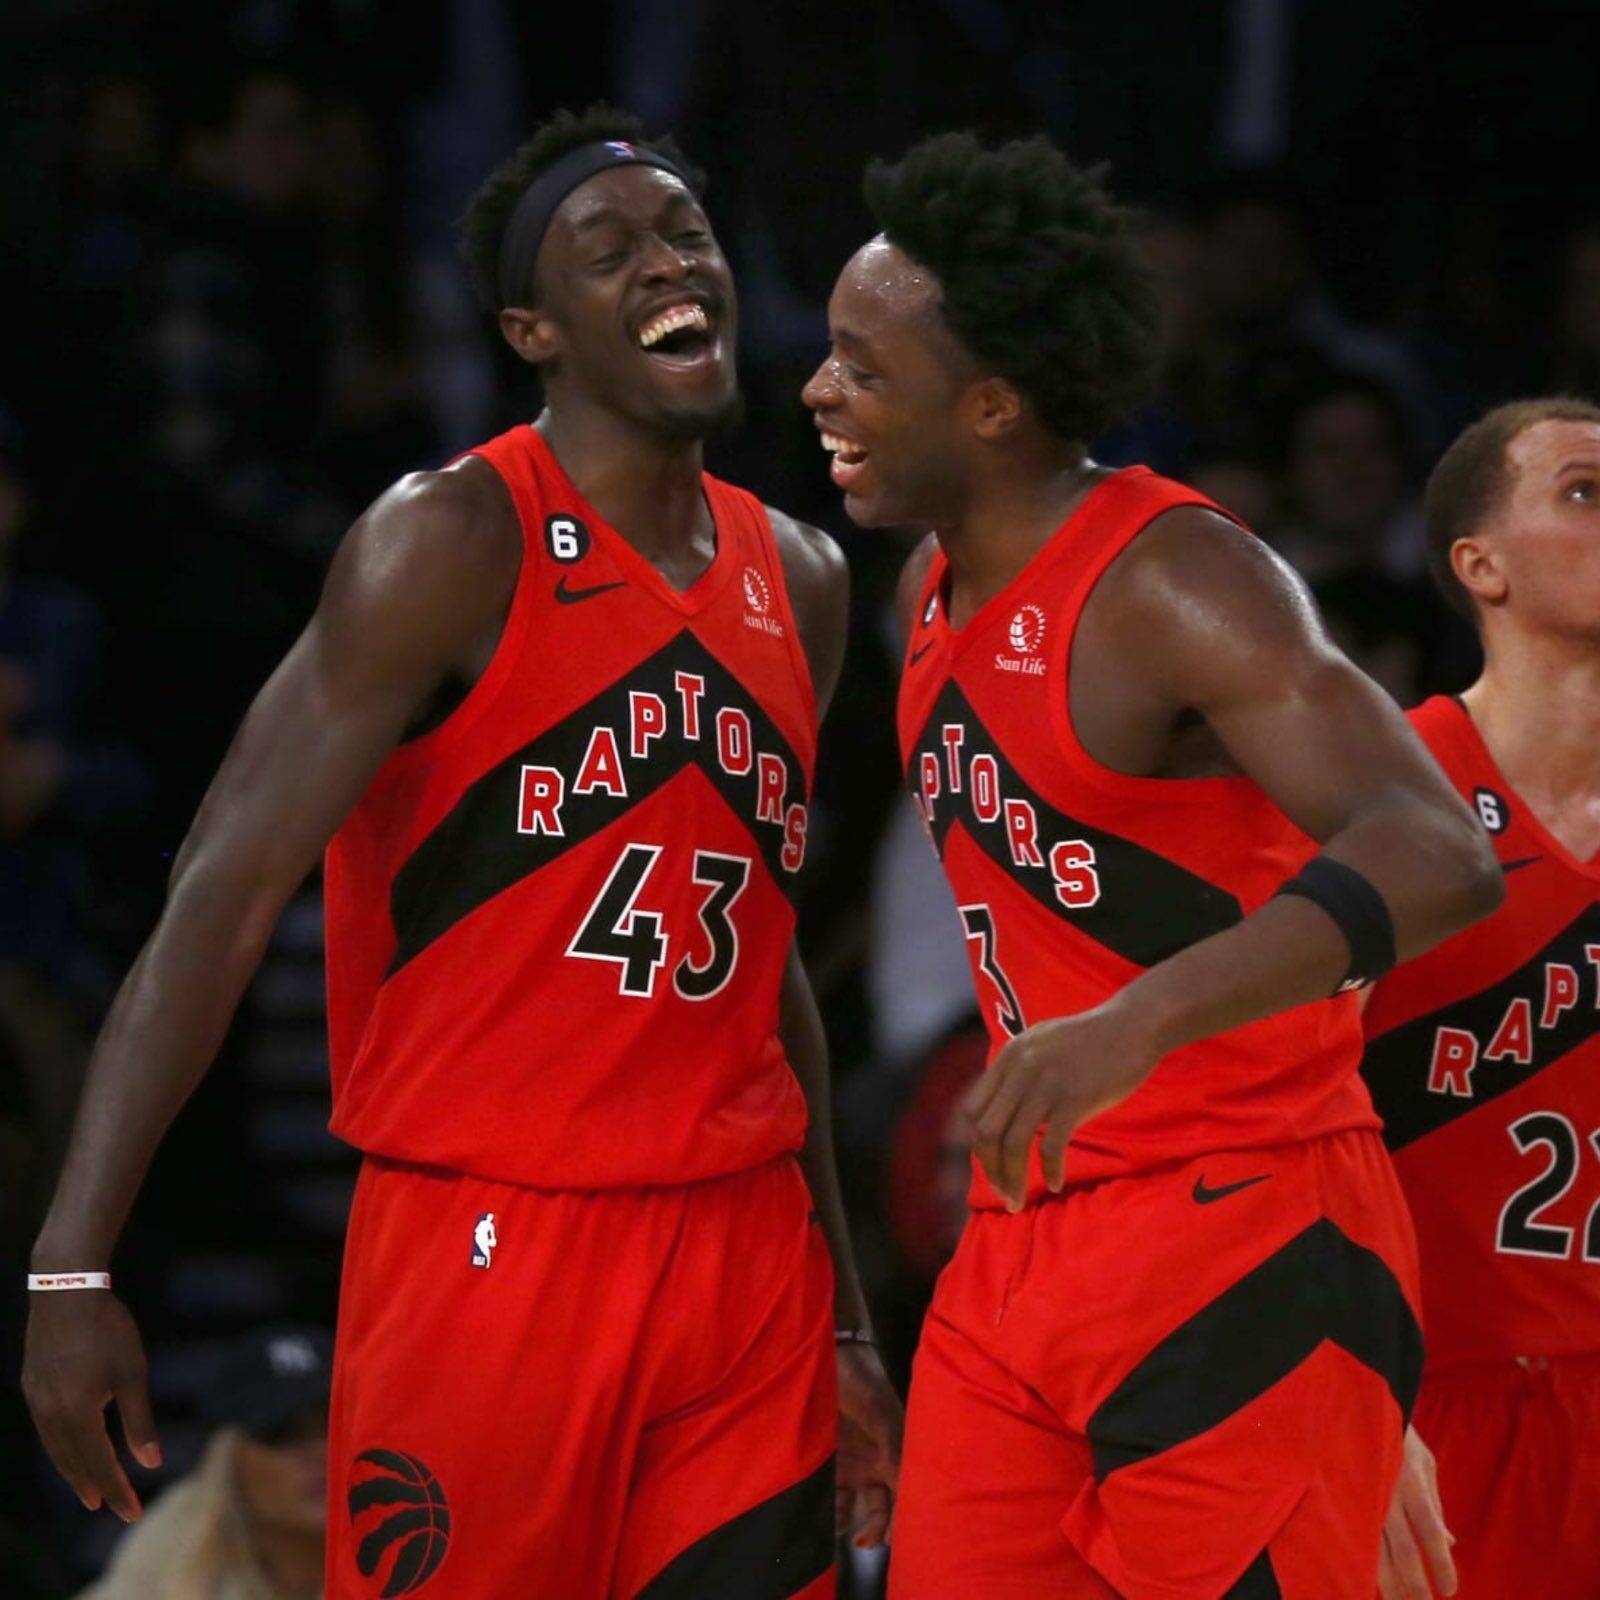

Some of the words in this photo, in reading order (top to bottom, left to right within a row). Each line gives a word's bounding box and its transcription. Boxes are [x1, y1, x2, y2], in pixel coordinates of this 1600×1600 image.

[551, 521, 578, 558] 6
[995, 654, 1020, 672] Sun
[1021, 657, 1046, 676] Life
[517, 670, 808, 873] RAPTORS
[913, 723, 1101, 908] PTORS
[1476, 793, 1501, 830] 6
[564, 843, 752, 1002] 43
[957, 903, 1027, 1039] 3
[1495, 1111, 1600, 1263] 2
